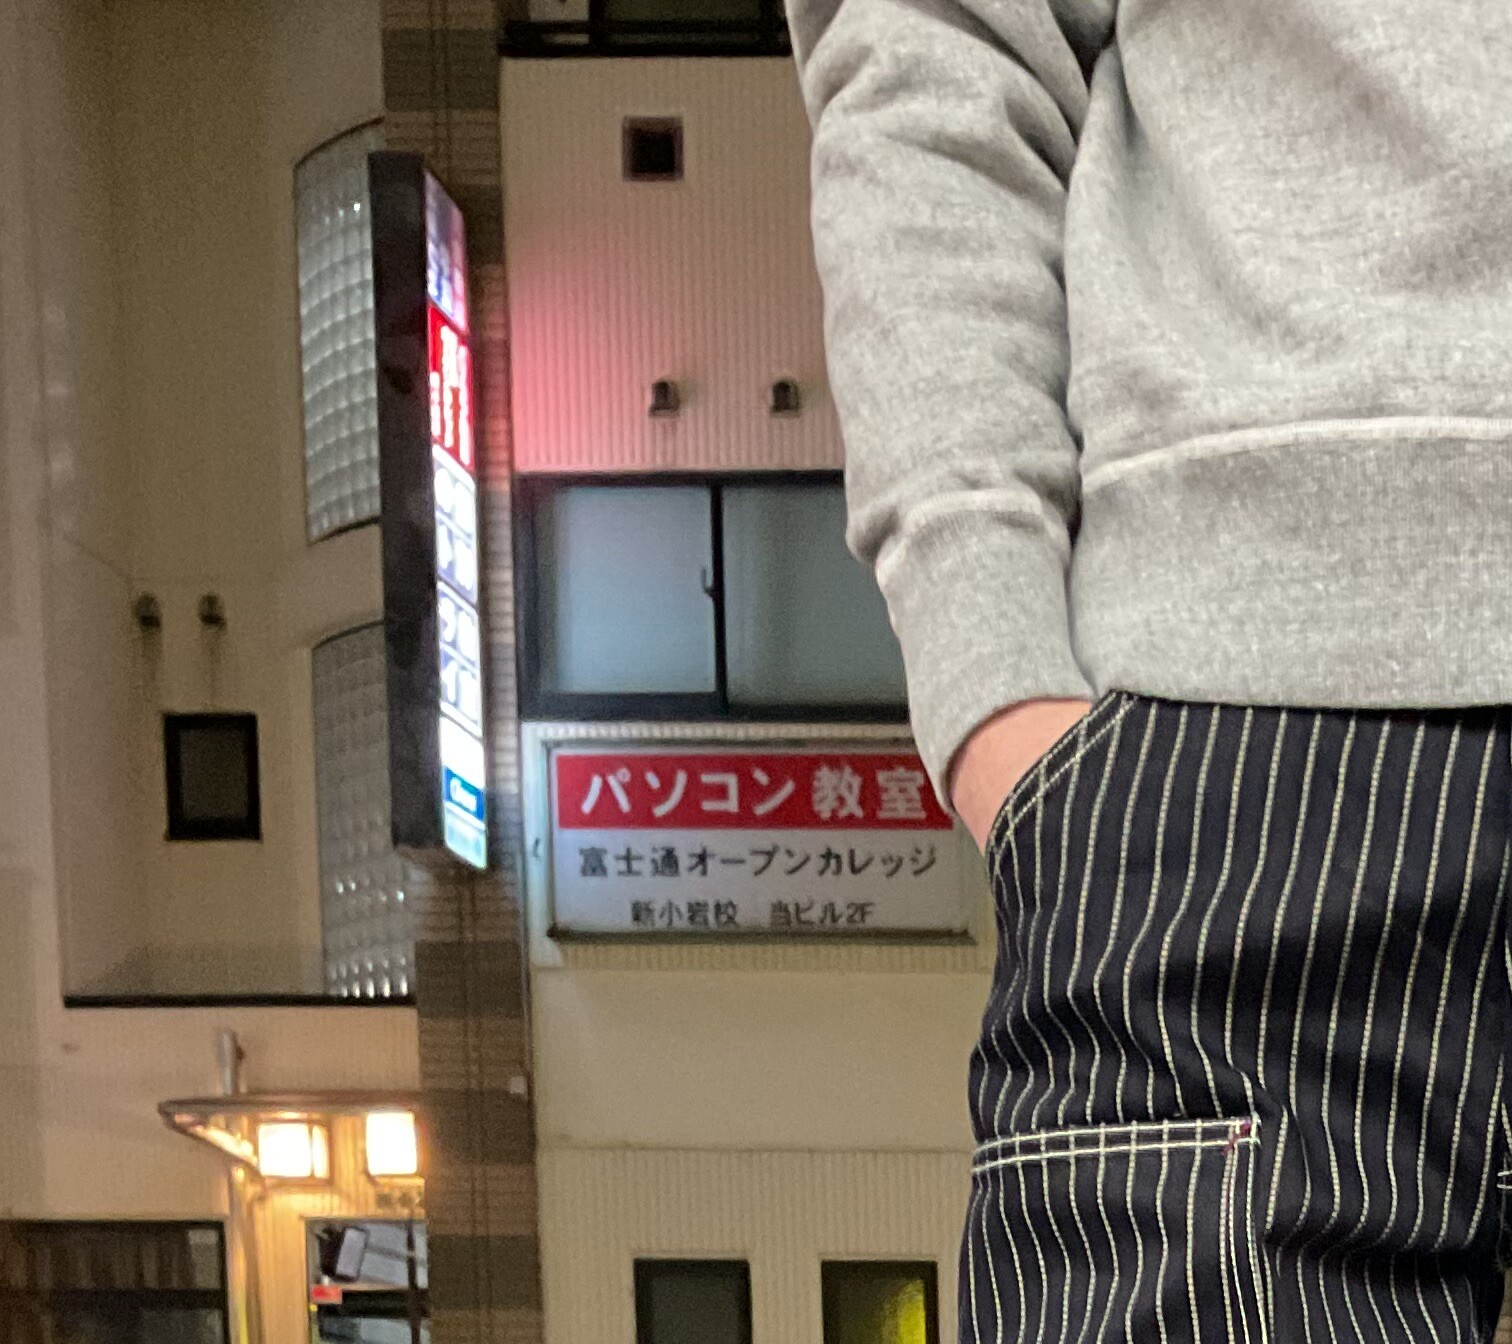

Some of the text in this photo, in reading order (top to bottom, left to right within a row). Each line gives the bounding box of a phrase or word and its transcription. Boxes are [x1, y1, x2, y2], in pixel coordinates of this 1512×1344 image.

[580, 765, 928, 820] パソコン教室
[579, 844, 938, 878] 富士通オープンカレッジ
